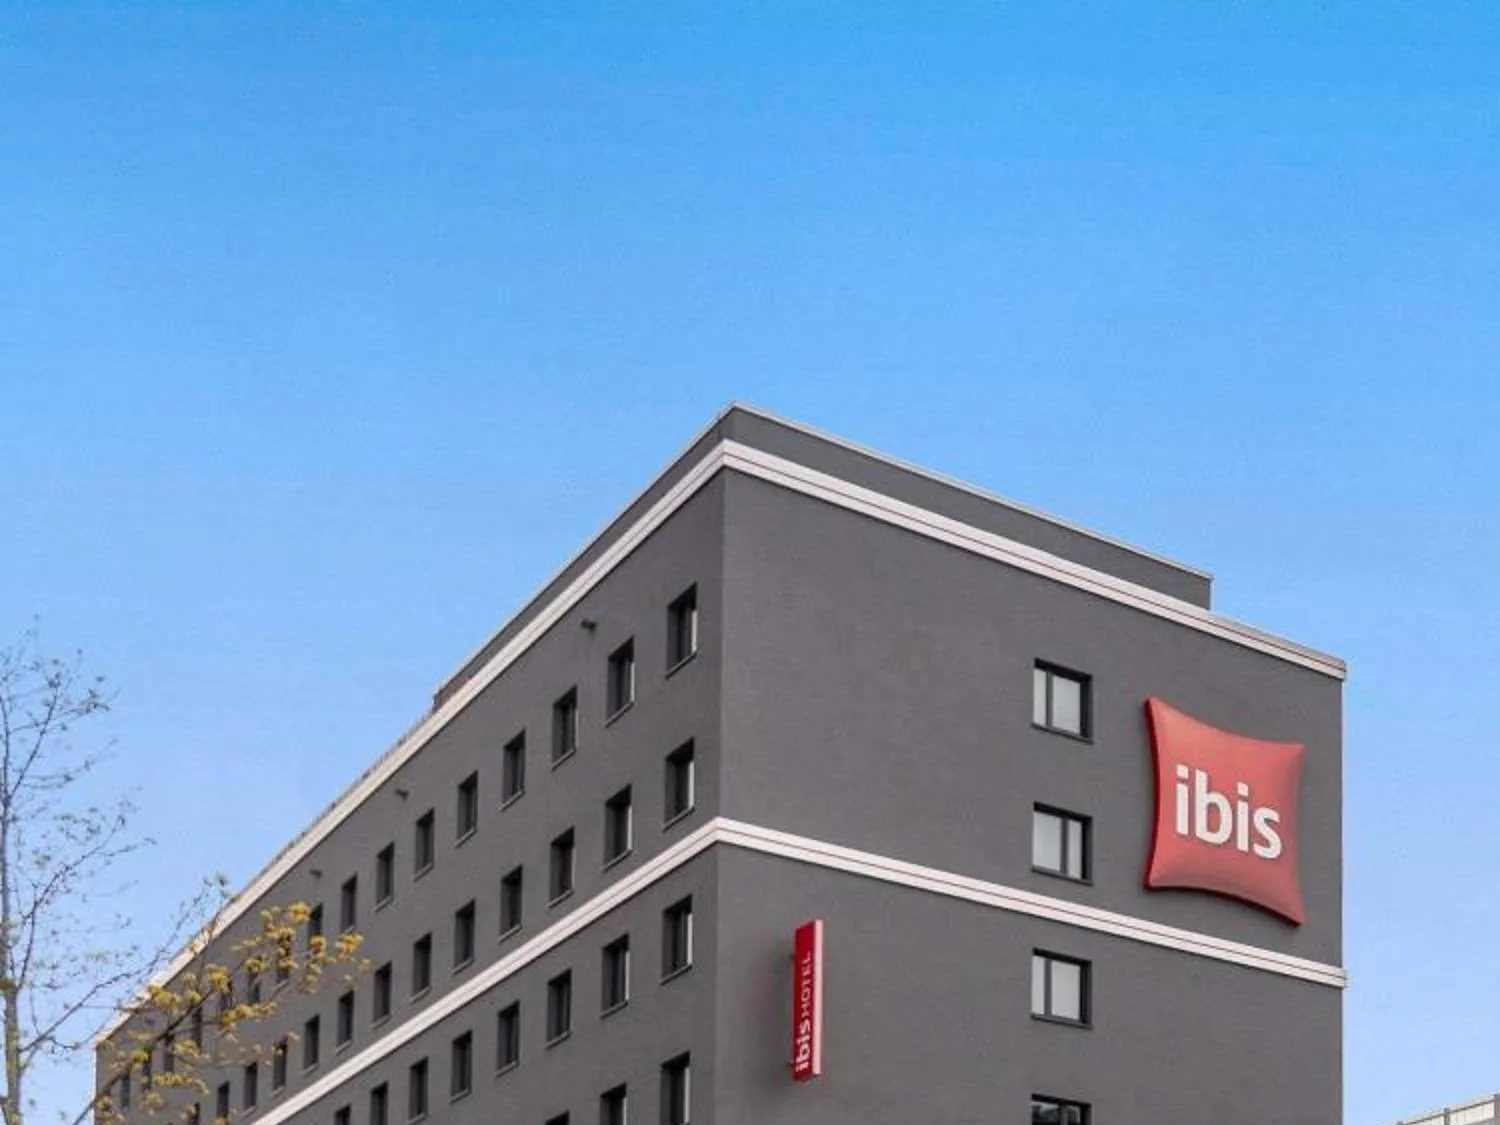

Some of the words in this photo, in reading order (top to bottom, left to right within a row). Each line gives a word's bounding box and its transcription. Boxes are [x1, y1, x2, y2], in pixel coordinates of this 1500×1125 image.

[1175, 764, 1282, 859] ibis
[801, 951, 811, 1018] HOTEL
[796, 1019, 811, 1072] ibis
